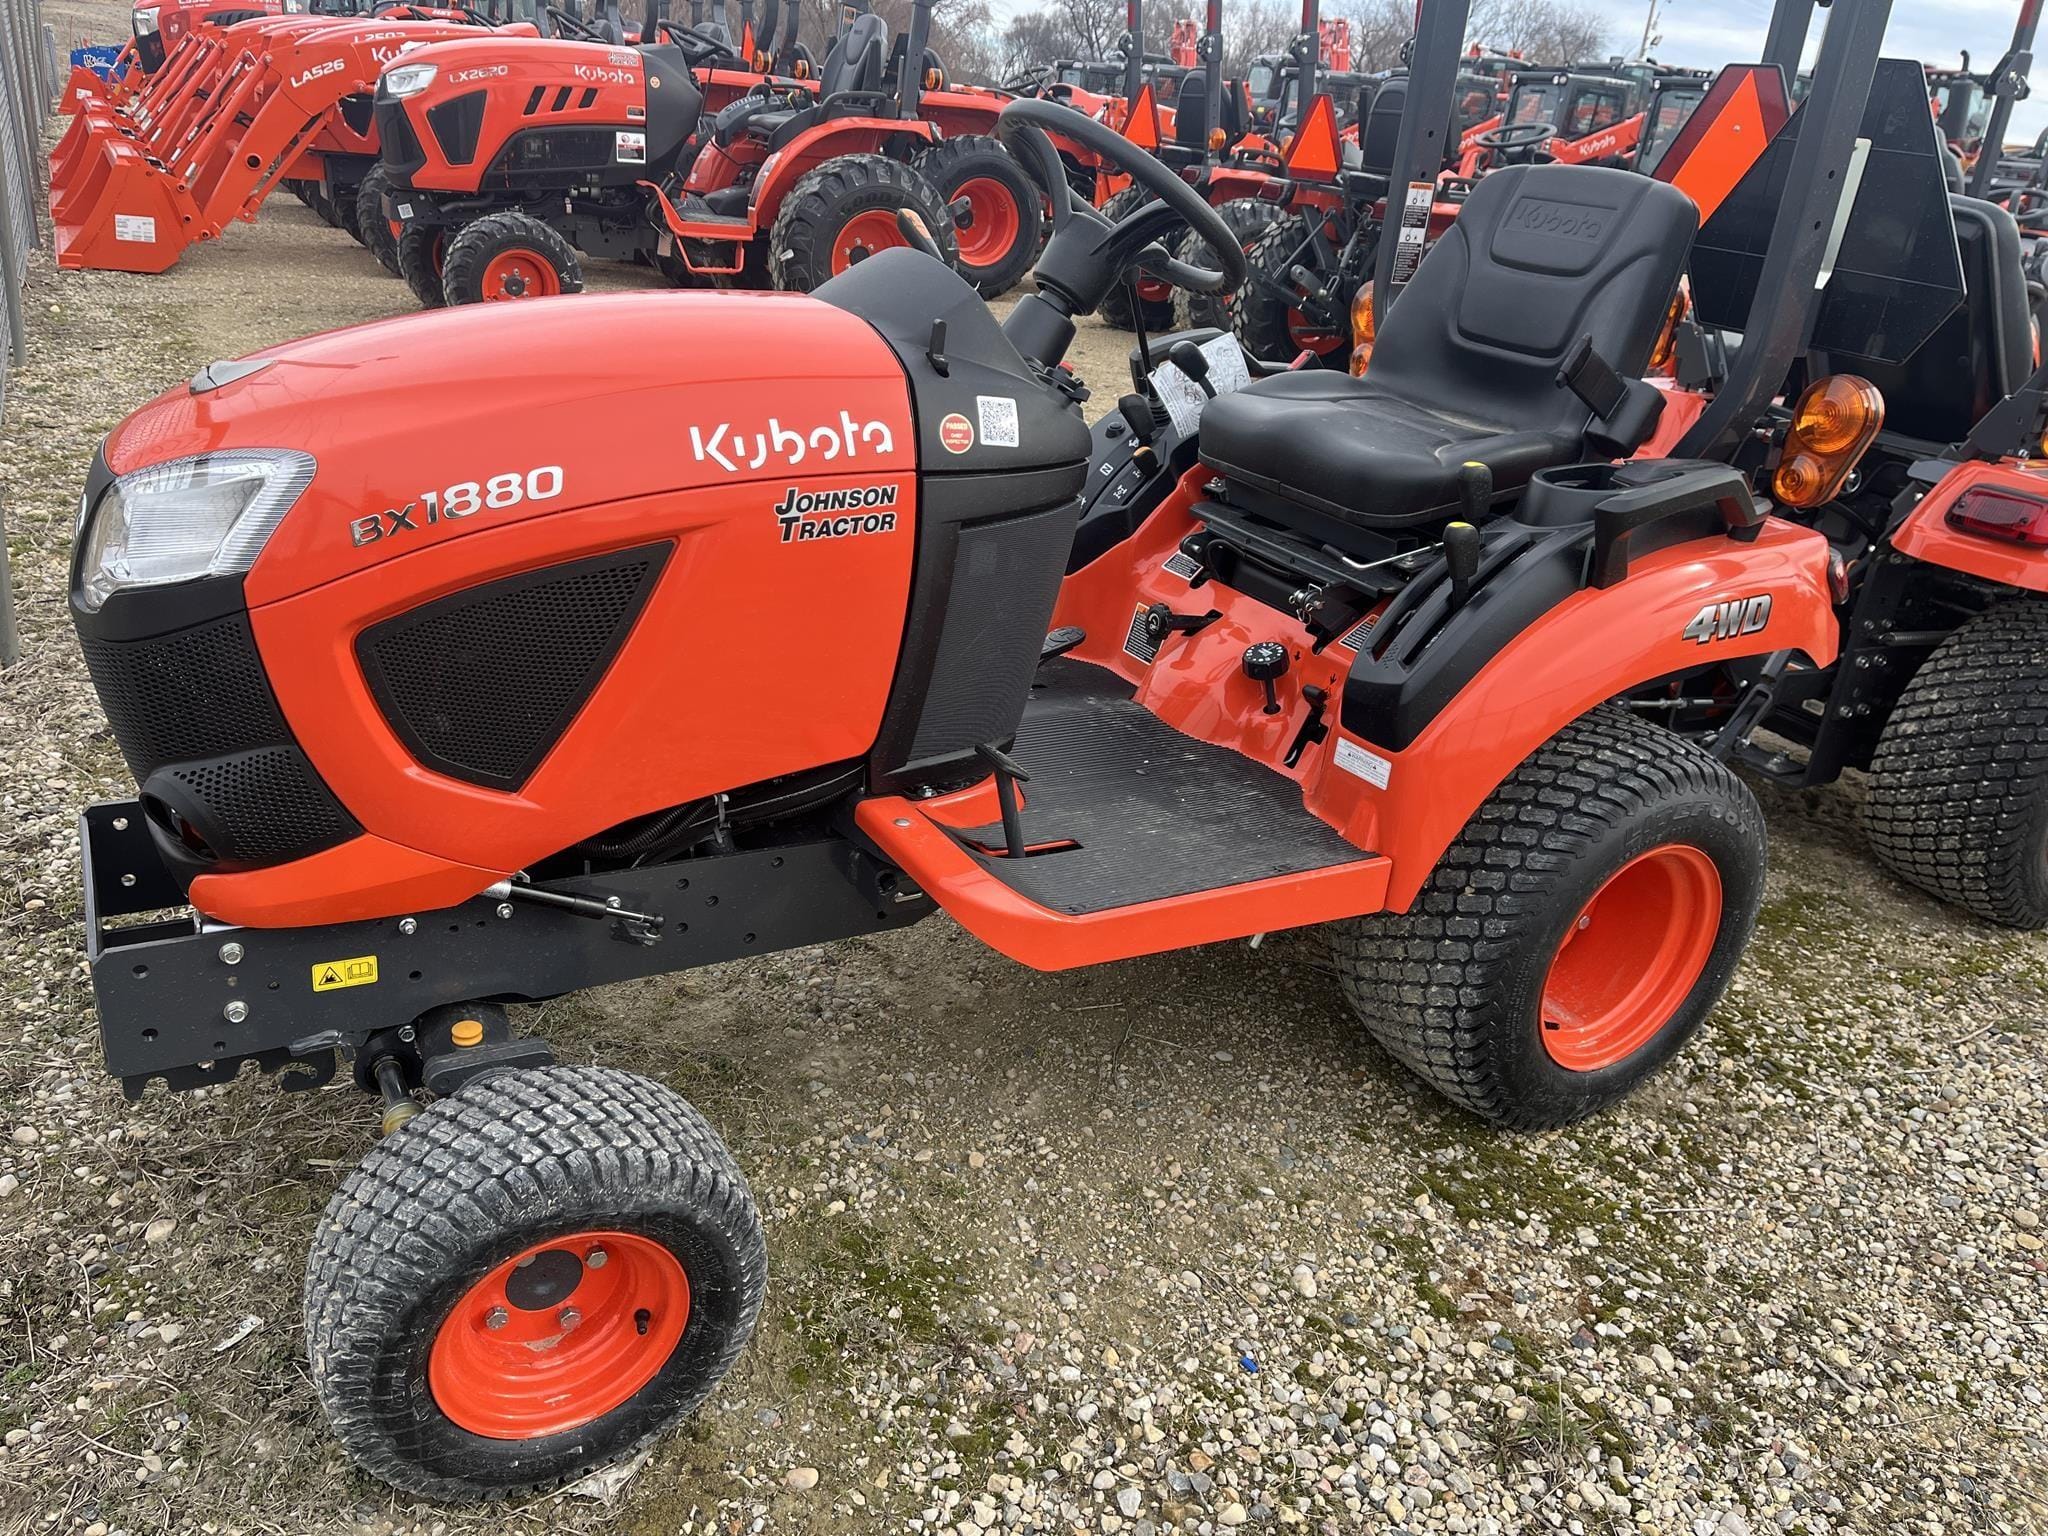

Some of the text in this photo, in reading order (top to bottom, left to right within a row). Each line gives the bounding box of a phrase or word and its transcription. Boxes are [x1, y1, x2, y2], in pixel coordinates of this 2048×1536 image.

[291, 58, 345, 88] LA526
[574, 64, 635, 84] Kubota
[1579, 134, 1616, 155] Kubota
[1516, 203, 1602, 239] Kubota
[689, 410, 894, 472] Kubota
[774, 485, 899, 517] JOHNSON
[777, 511, 897, 544] TRACTOR
[1682, 593, 1773, 645] 4WD
